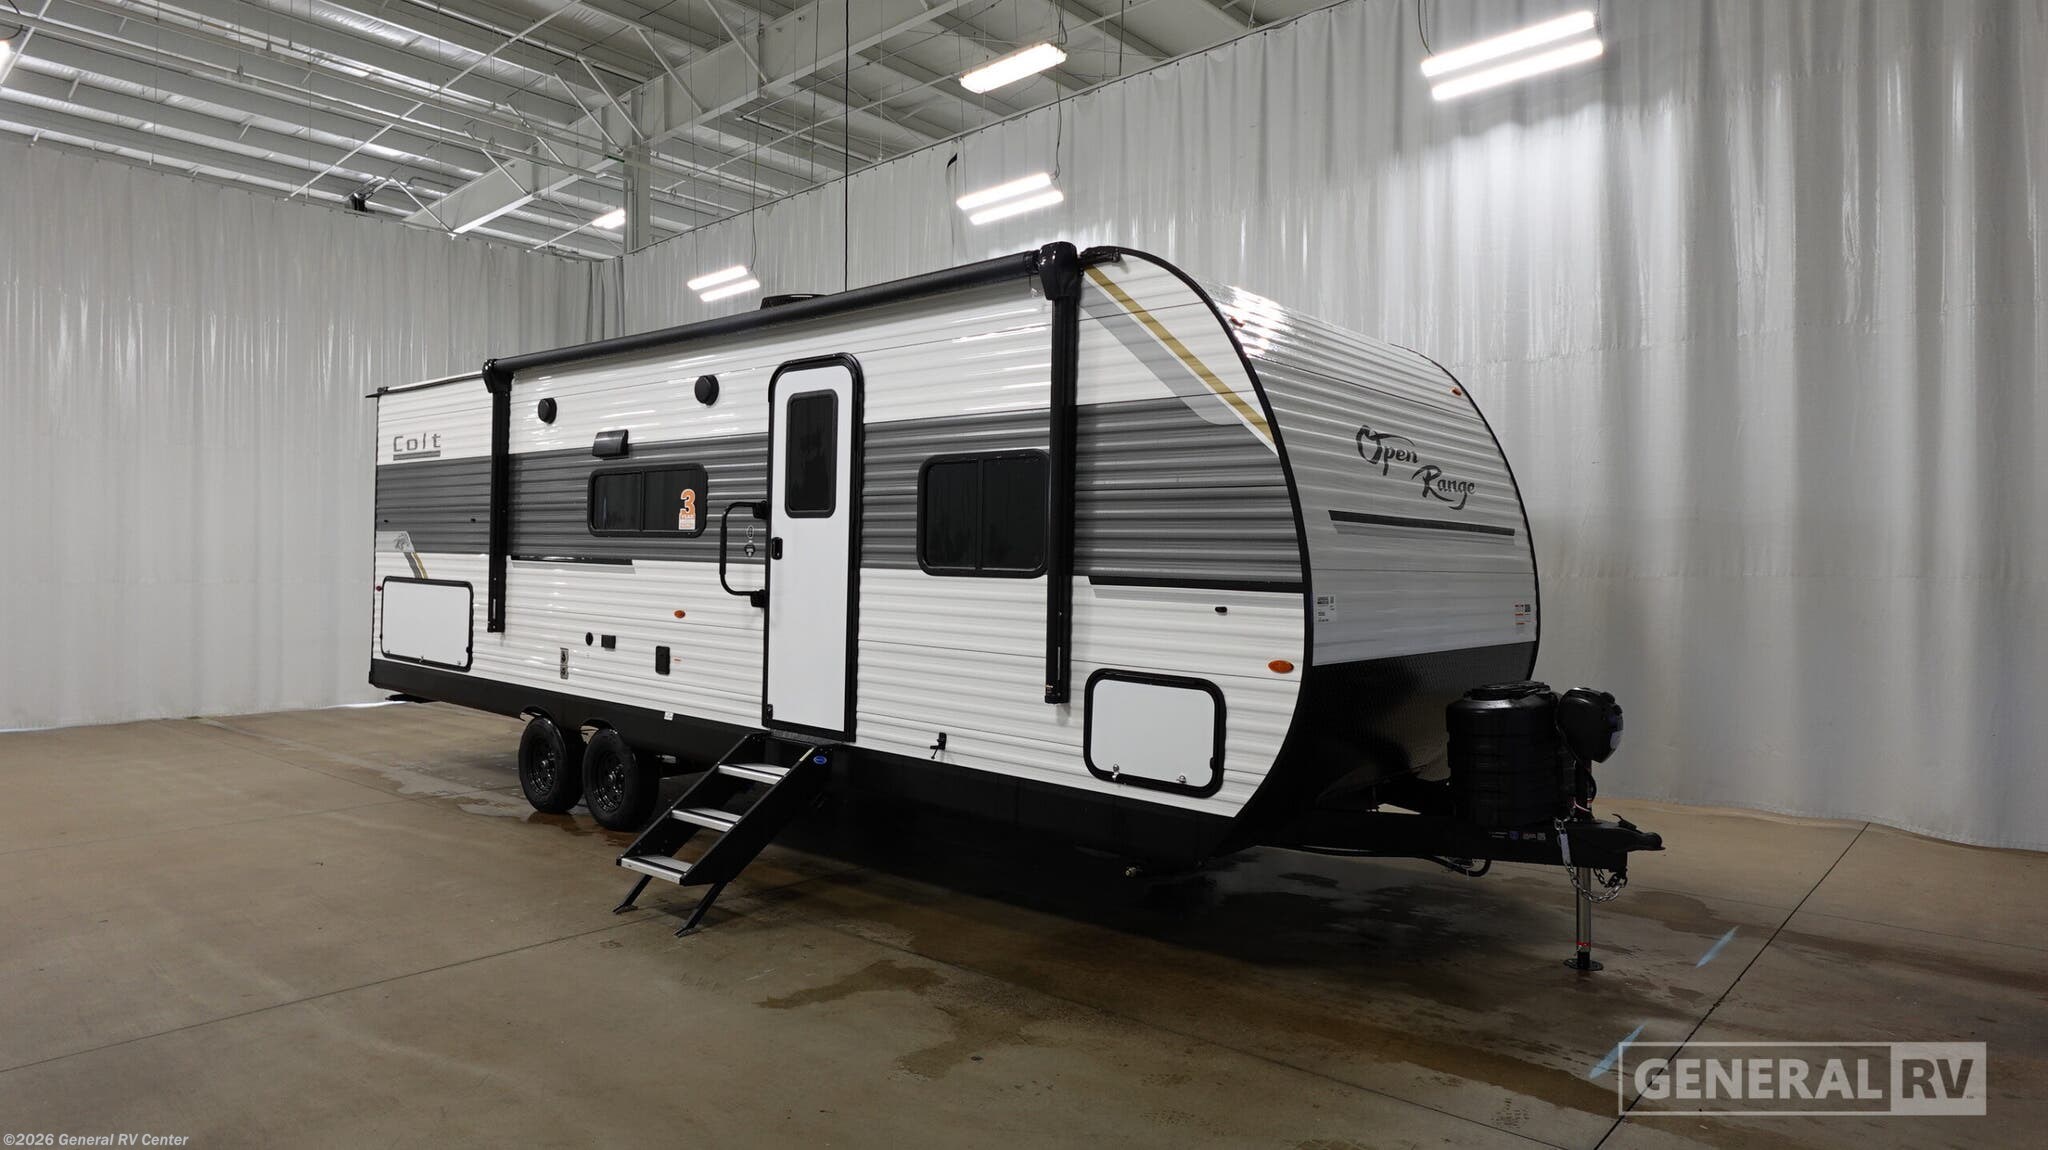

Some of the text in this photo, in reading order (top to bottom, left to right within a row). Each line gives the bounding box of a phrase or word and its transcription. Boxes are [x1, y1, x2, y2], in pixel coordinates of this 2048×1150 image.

[393, 433, 441, 452] Colt
[1356, 425, 1418, 476] Open
[681, 489, 696, 515] 3
[1411, 466, 1475, 510] Range
